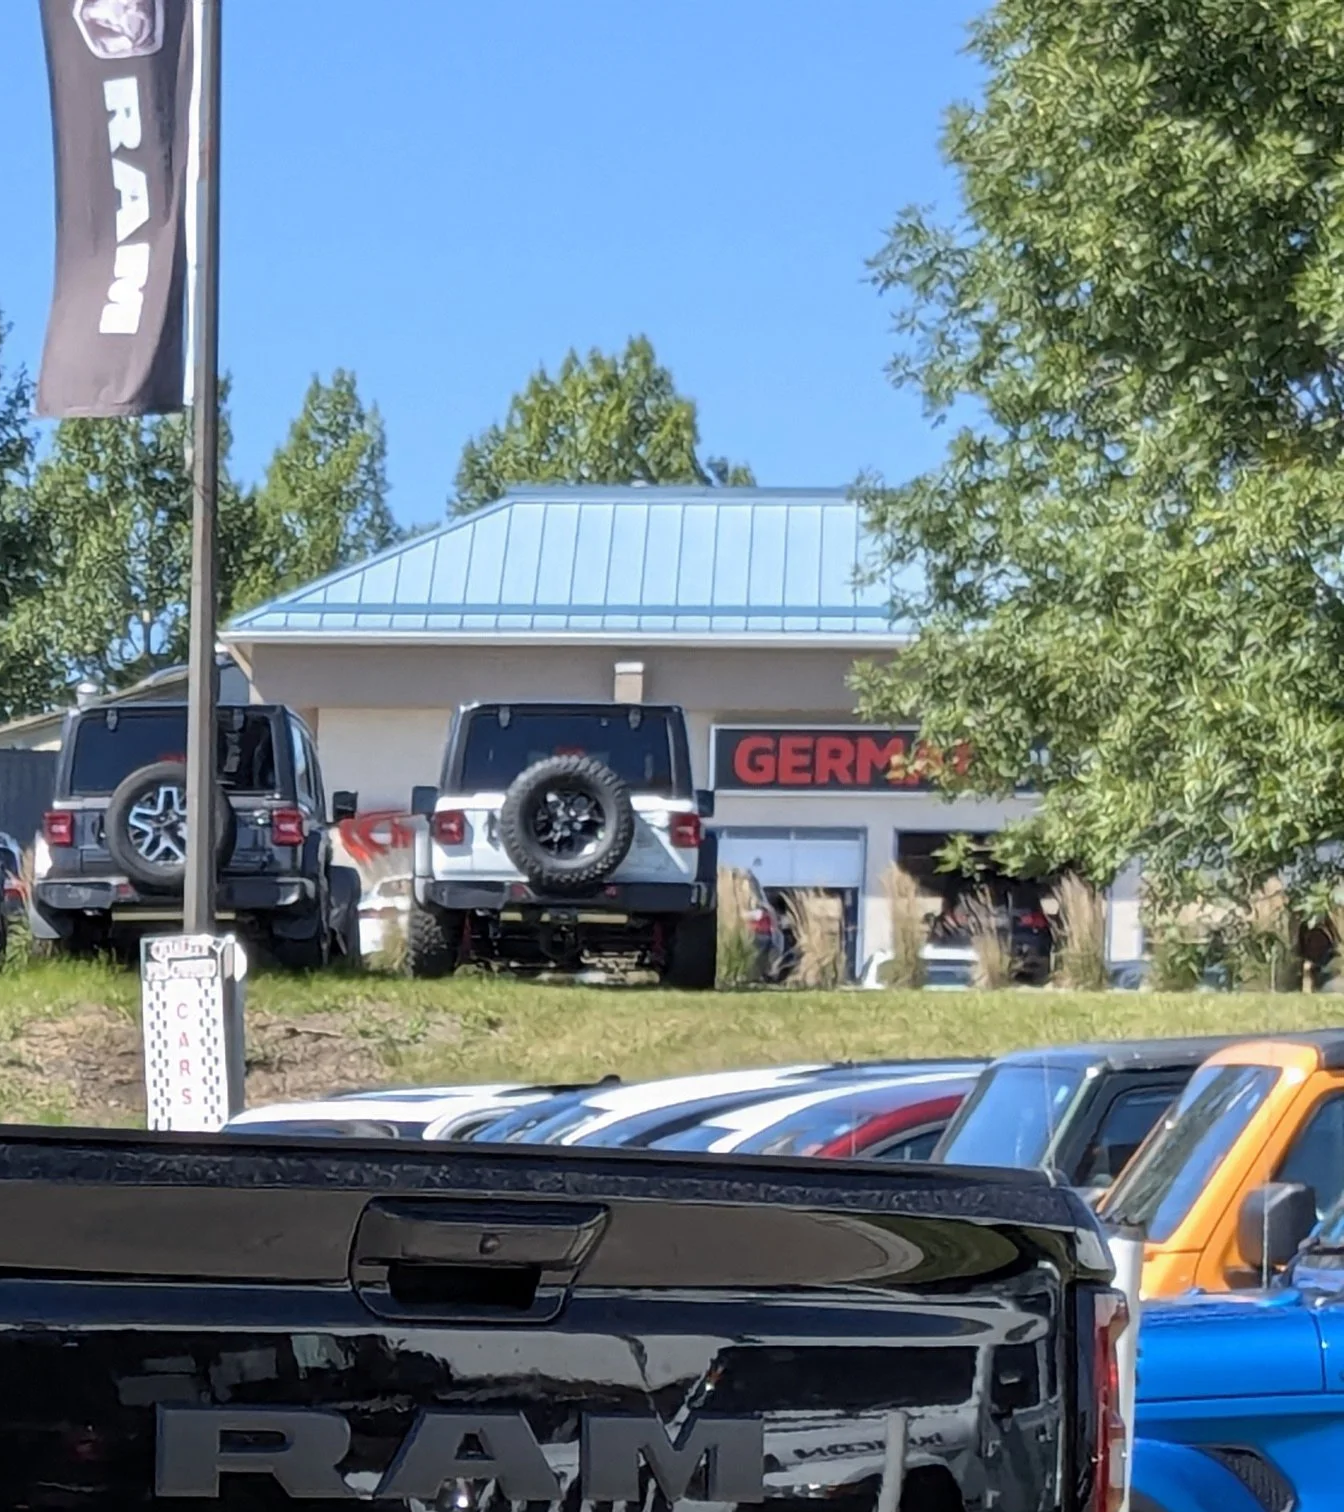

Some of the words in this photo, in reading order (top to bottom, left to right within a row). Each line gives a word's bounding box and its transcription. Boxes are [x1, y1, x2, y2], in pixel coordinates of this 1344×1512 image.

[99, 76, 150, 334] RAM
[176, 1002, 192, 1105] CARS
[154, 1401, 764, 1503] RAM
